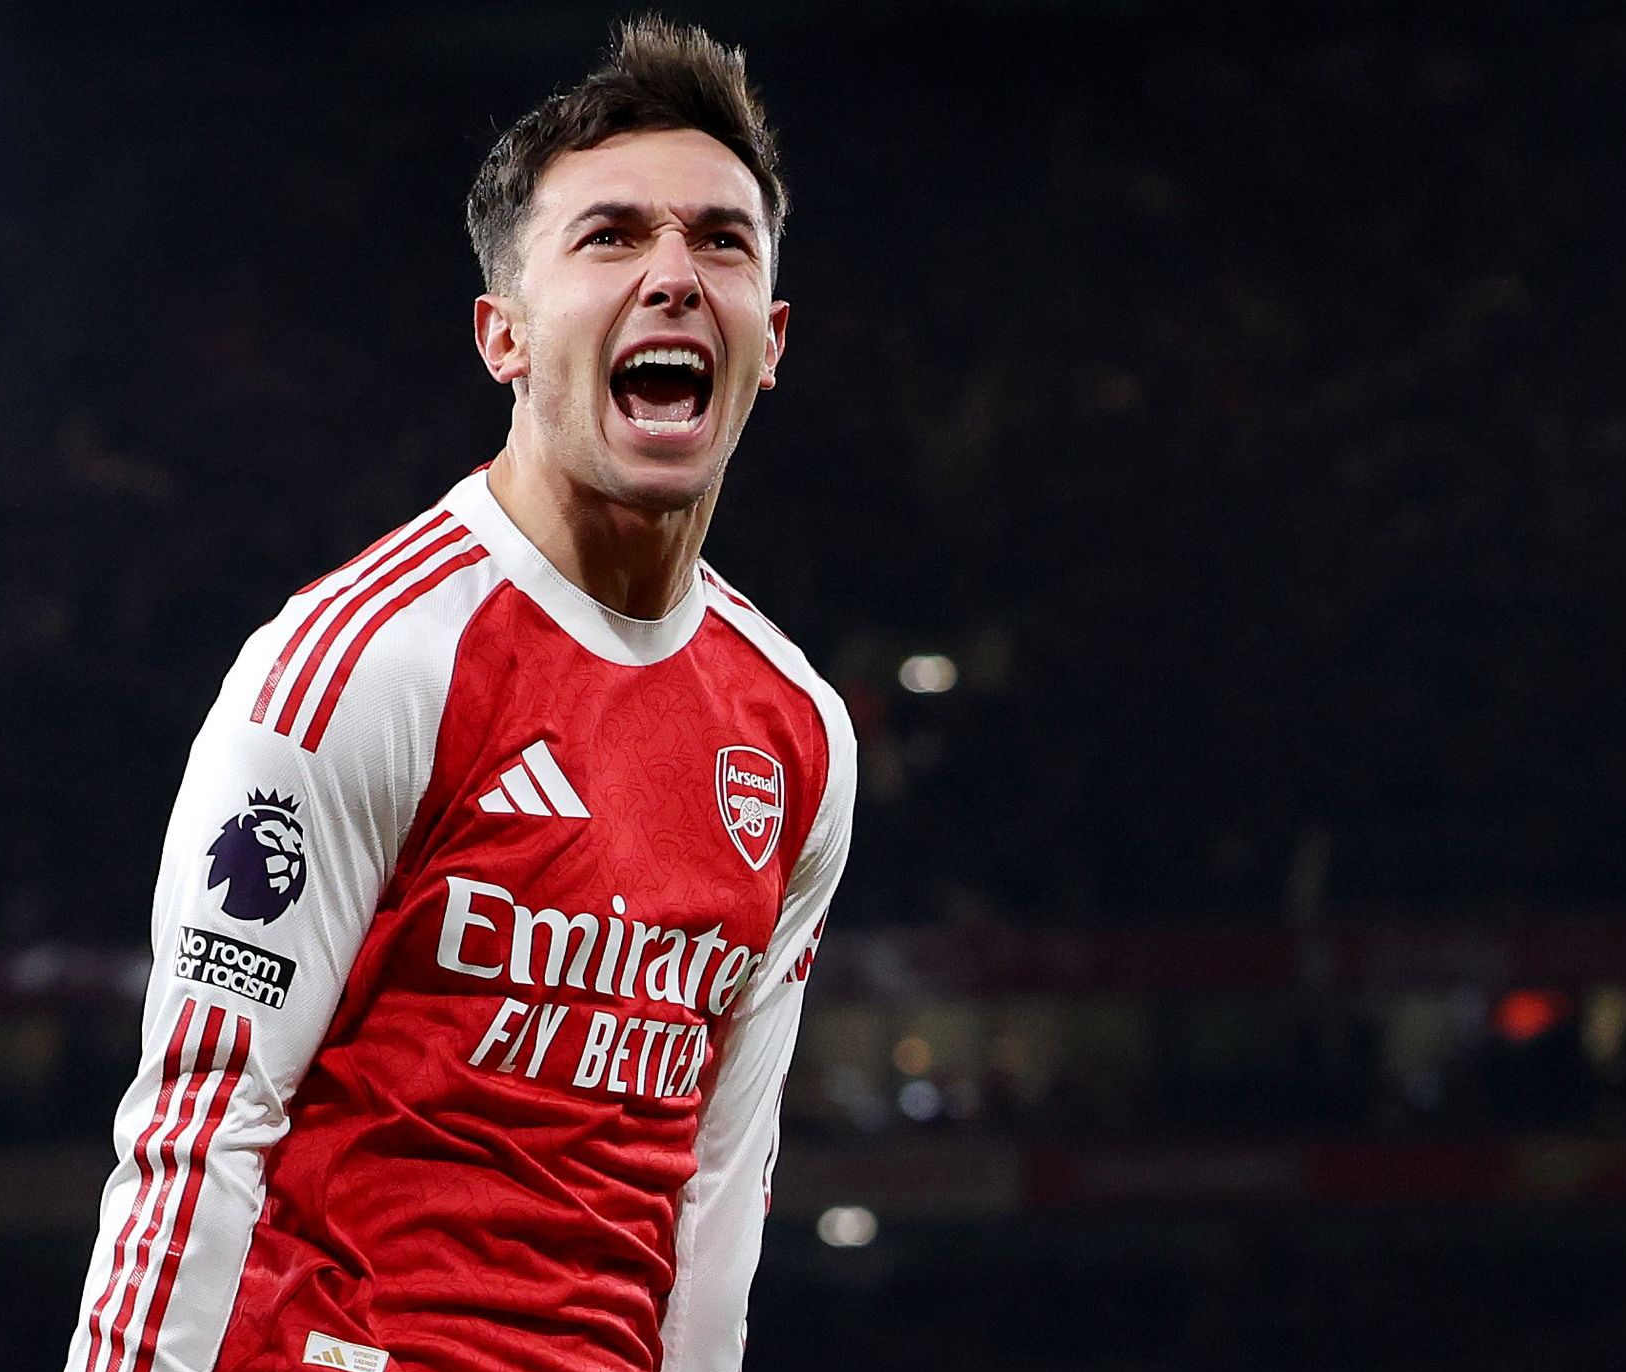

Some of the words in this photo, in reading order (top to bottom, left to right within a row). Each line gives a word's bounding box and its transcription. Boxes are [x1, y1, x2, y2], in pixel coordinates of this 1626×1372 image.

[727, 765, 776, 794] Arsenal
[176, 927, 207, 956] No
[209, 940, 281, 983] room
[201, 961, 285, 1008] racism
[468, 997, 570, 1079] FLY
[572, 1010, 708, 1099] BETTER
